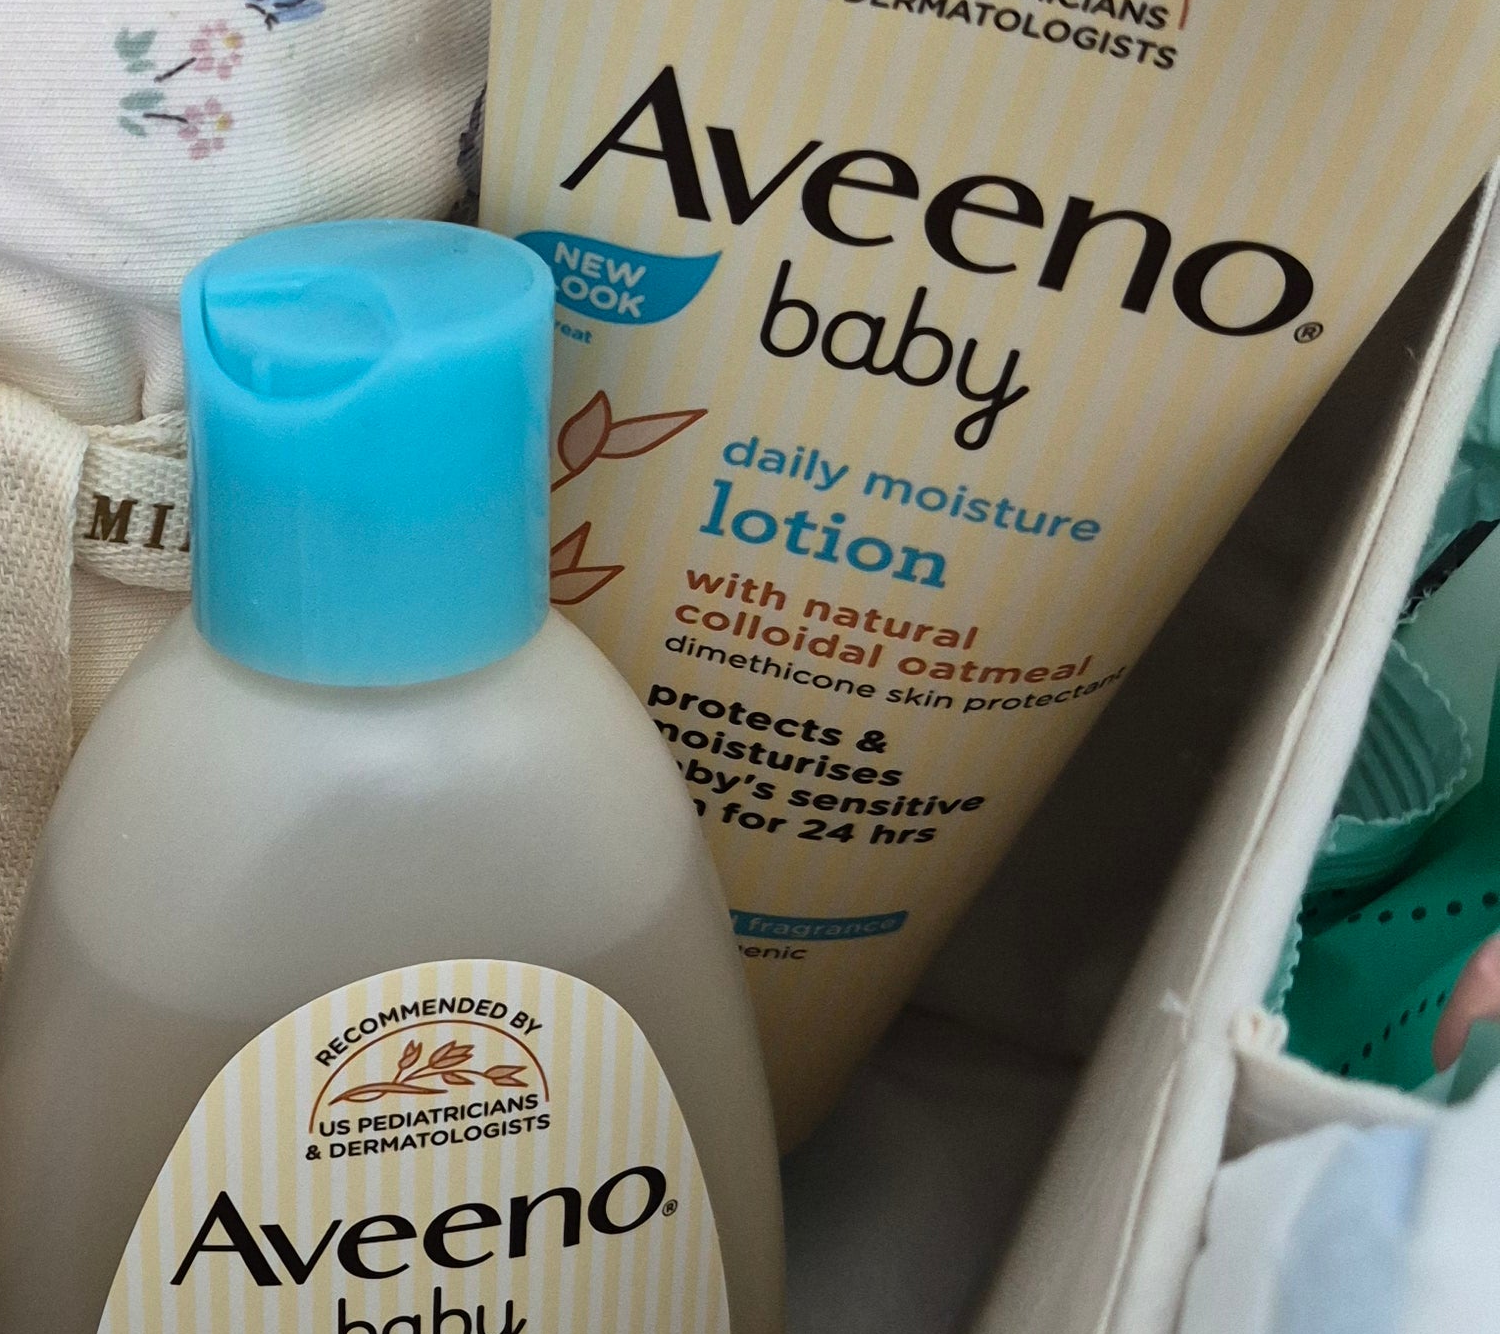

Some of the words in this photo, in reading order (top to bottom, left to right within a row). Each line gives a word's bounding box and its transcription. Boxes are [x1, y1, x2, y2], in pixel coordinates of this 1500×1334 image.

[554, 241, 647, 288] NEW
[556, 276, 645, 318] OOK
[555, 319, 592, 344] eat
[759, 260, 1029, 451] baby
[722, 436, 849, 492] daily
[863, 471, 1101, 543] moisture
[699, 479, 947, 590] lotion
[685, 568, 786, 611] with
[802, 598, 979, 650] natural
[665, 634, 875, 699] dimethicone
[886, 685, 953, 710] skin
[675, 603, 883, 669] colloidal
[897, 654, 1094, 685] oatmeal
[648, 684, 843, 747] protects
[856, 730, 888, 754] &
[676, 758, 776, 800] by's
[787, 787, 986, 817] sensitive
[721, 802, 787, 834] for
[797, 819, 854, 844] 24
[870, 824, 937, 845] hrs
[749, 917, 896, 938] fragrance
[315, 997, 508, 1067] RECOMMENDED
[509, 1011, 543, 1037] BY
[305, 1144, 322, 1161] &
[329, 1113, 551, 1159] DERMATOLOGISTS
[319, 1119, 350, 1137] US
[358, 1093, 539, 1133] PEDIATRICIANS
